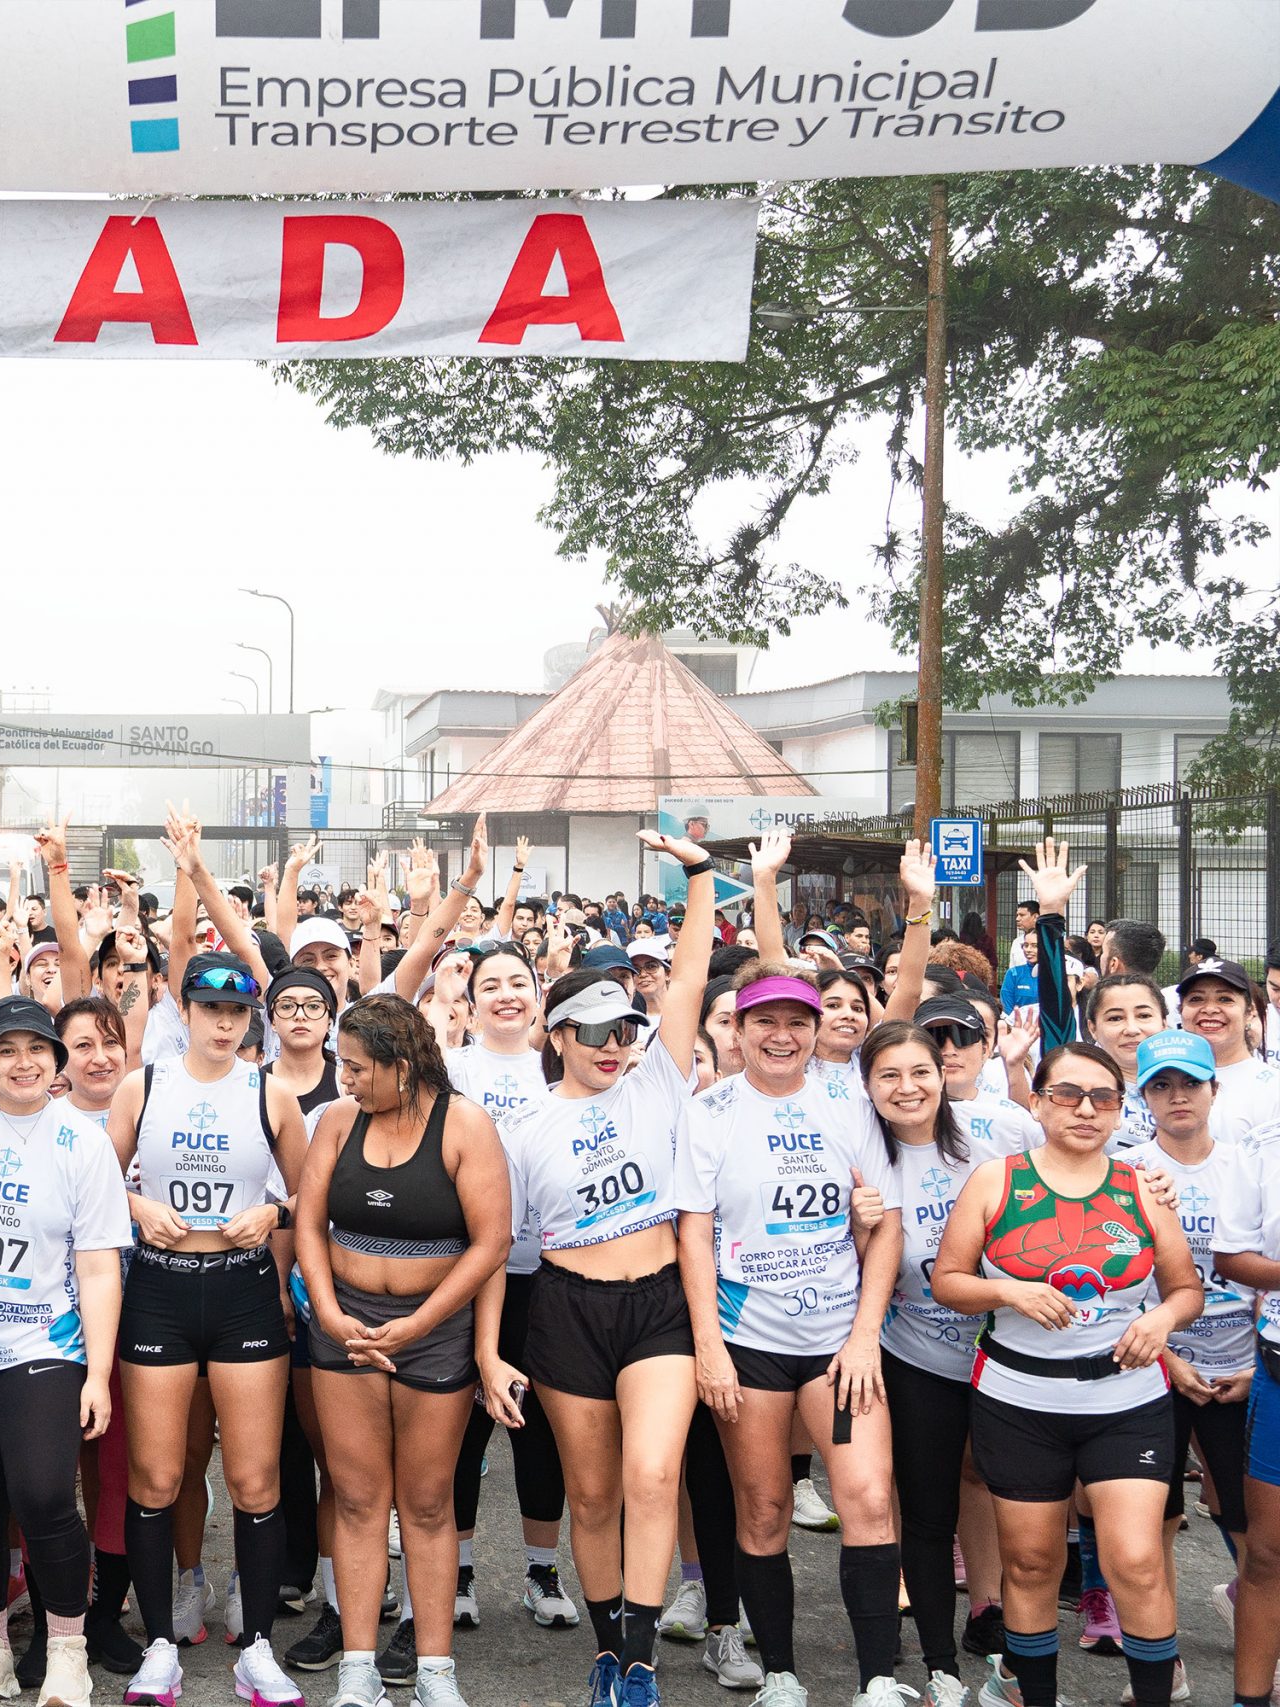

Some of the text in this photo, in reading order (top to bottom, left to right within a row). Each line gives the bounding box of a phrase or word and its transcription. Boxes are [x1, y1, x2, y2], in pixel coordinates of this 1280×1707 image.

[219, 57, 998, 118] Empresa Pública Municipal
[214, 100, 1067, 154] Transporte Terrestre y Tránsito
[50, 727, 114, 740] Universidad
[129, 726, 189, 742] SANTO
[43, 738, 61, 750] del
[62, 739, 106, 751] Ecuador
[129, 740, 215, 757] DOMINGO
[774, 812, 816, 827] PUCE
[941, 857, 972, 871] TAXI
[1147, 1035, 1195, 1051] WELLMAX
[827, 1082, 851, 1101] 5K
[56, 1124, 80, 1152] 5K
[970, 1118, 995, 1141] 5K
[171, 1131, 230, 1152] PUCE
[571, 1120, 619, 1157] PUCE
[767, 1132, 826, 1153] PUCE
[182, 1153, 220, 1164] SANTO
[581, 1148, 627, 1176] DOMINGO
[781, 1154, 819, 1166] SANTO
[175, 1162, 227, 1174] DOMINGO
[777, 1163, 828, 1177] DOMINGO
[168, 1180, 235, 1214] 097
[576, 1161, 645, 1217] 300
[367, 1200, 392, 1208] umbro
[771, 1181, 841, 1220] 428
[184, 1217, 213, 1226] UCESD
[788, 1222, 819, 1232] PUCESD
[583, 1234, 605, 1247] POR
[605, 1228, 620, 1241] LA
[140, 1249, 170, 1264] NIKE
[168, 1258, 200, 1269] PRO
[225, 1250, 257, 1265] NIKE
[739, 1246, 814, 1264] CORRO POR LA
[741, 1255, 829, 1275] DE EDUCAR A LOS
[742, 1264, 828, 1284] SANTO DOMINGO
[783, 1286, 819, 1318] 30
[822, 1293, 834, 1303] fe,
[39, 1315, 54, 1324] DE
[133, 1343, 164, 1354] NIKE
[241, 1339, 270, 1349] PRO
